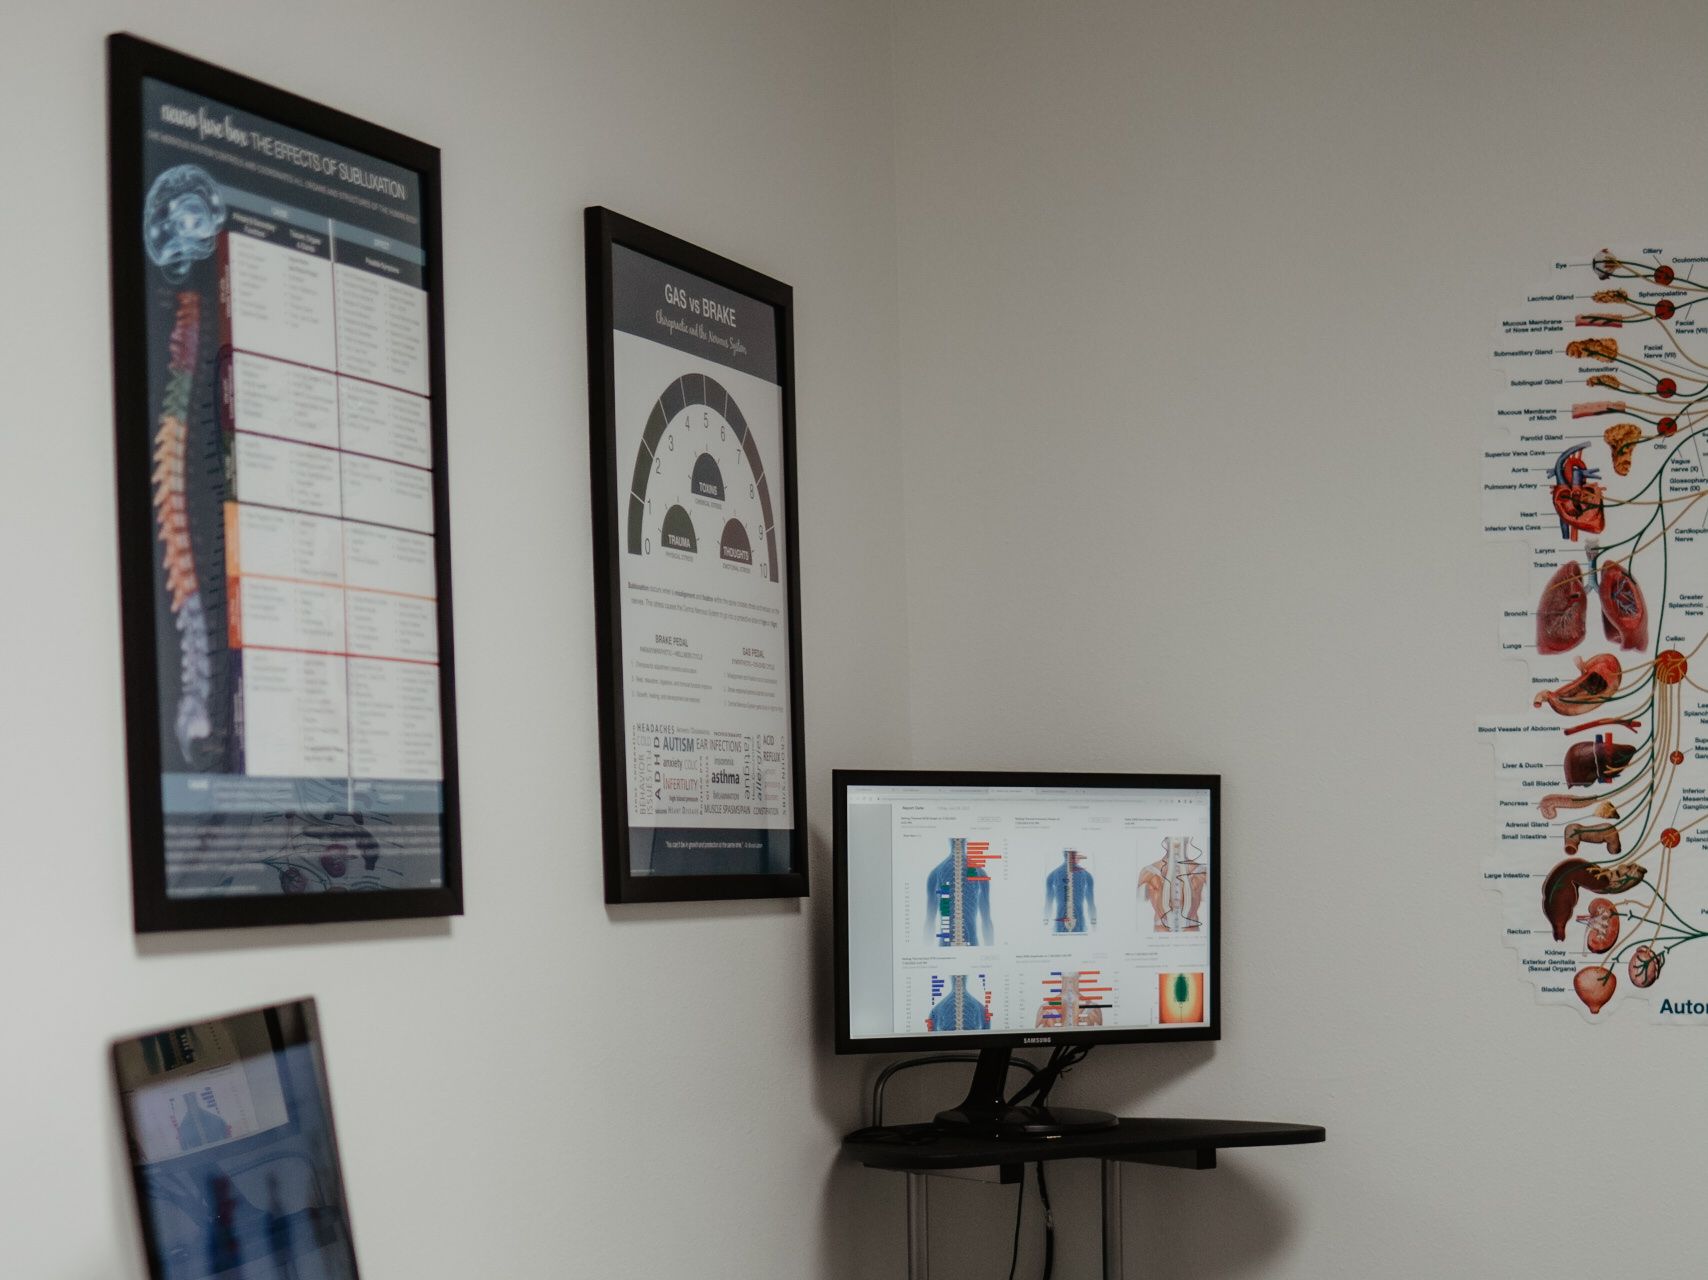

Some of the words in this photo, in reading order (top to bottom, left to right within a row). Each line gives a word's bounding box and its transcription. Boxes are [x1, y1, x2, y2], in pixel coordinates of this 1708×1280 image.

[249, 131, 273, 156] THE
[275, 140, 322, 172] EFFECTS
[322, 157, 337, 176] OF
[338, 163, 406, 200] SUBLUXATION
[664, 283, 687, 309] GAS
[689, 297, 700, 314] vs
[702, 298, 737, 328] BRAKE
[685, 416, 690, 431] 4
[704, 412, 709, 428] 5
[720, 426, 726, 441] 6
[668, 435, 674, 451] 3
[736, 449, 741, 464] 7
[655, 457, 661, 474] 2
[749, 483, 755, 499] 8
[758, 525, 763, 540] 9
[645, 538, 650, 555] 0
[668, 534, 690, 549] TRAUMA
[723, 546, 750, 561] THOUGHTS
[760, 563, 768, 578] 10
[655, 634, 672, 646] BRAKE
[636, 723, 675, 735] HEADACHES
[663, 737, 694, 752] AUTISM
[696, 738, 708, 750] EAR
[709, 738, 742, 753] INFECTIONS
[711, 768, 740, 784] asthma
